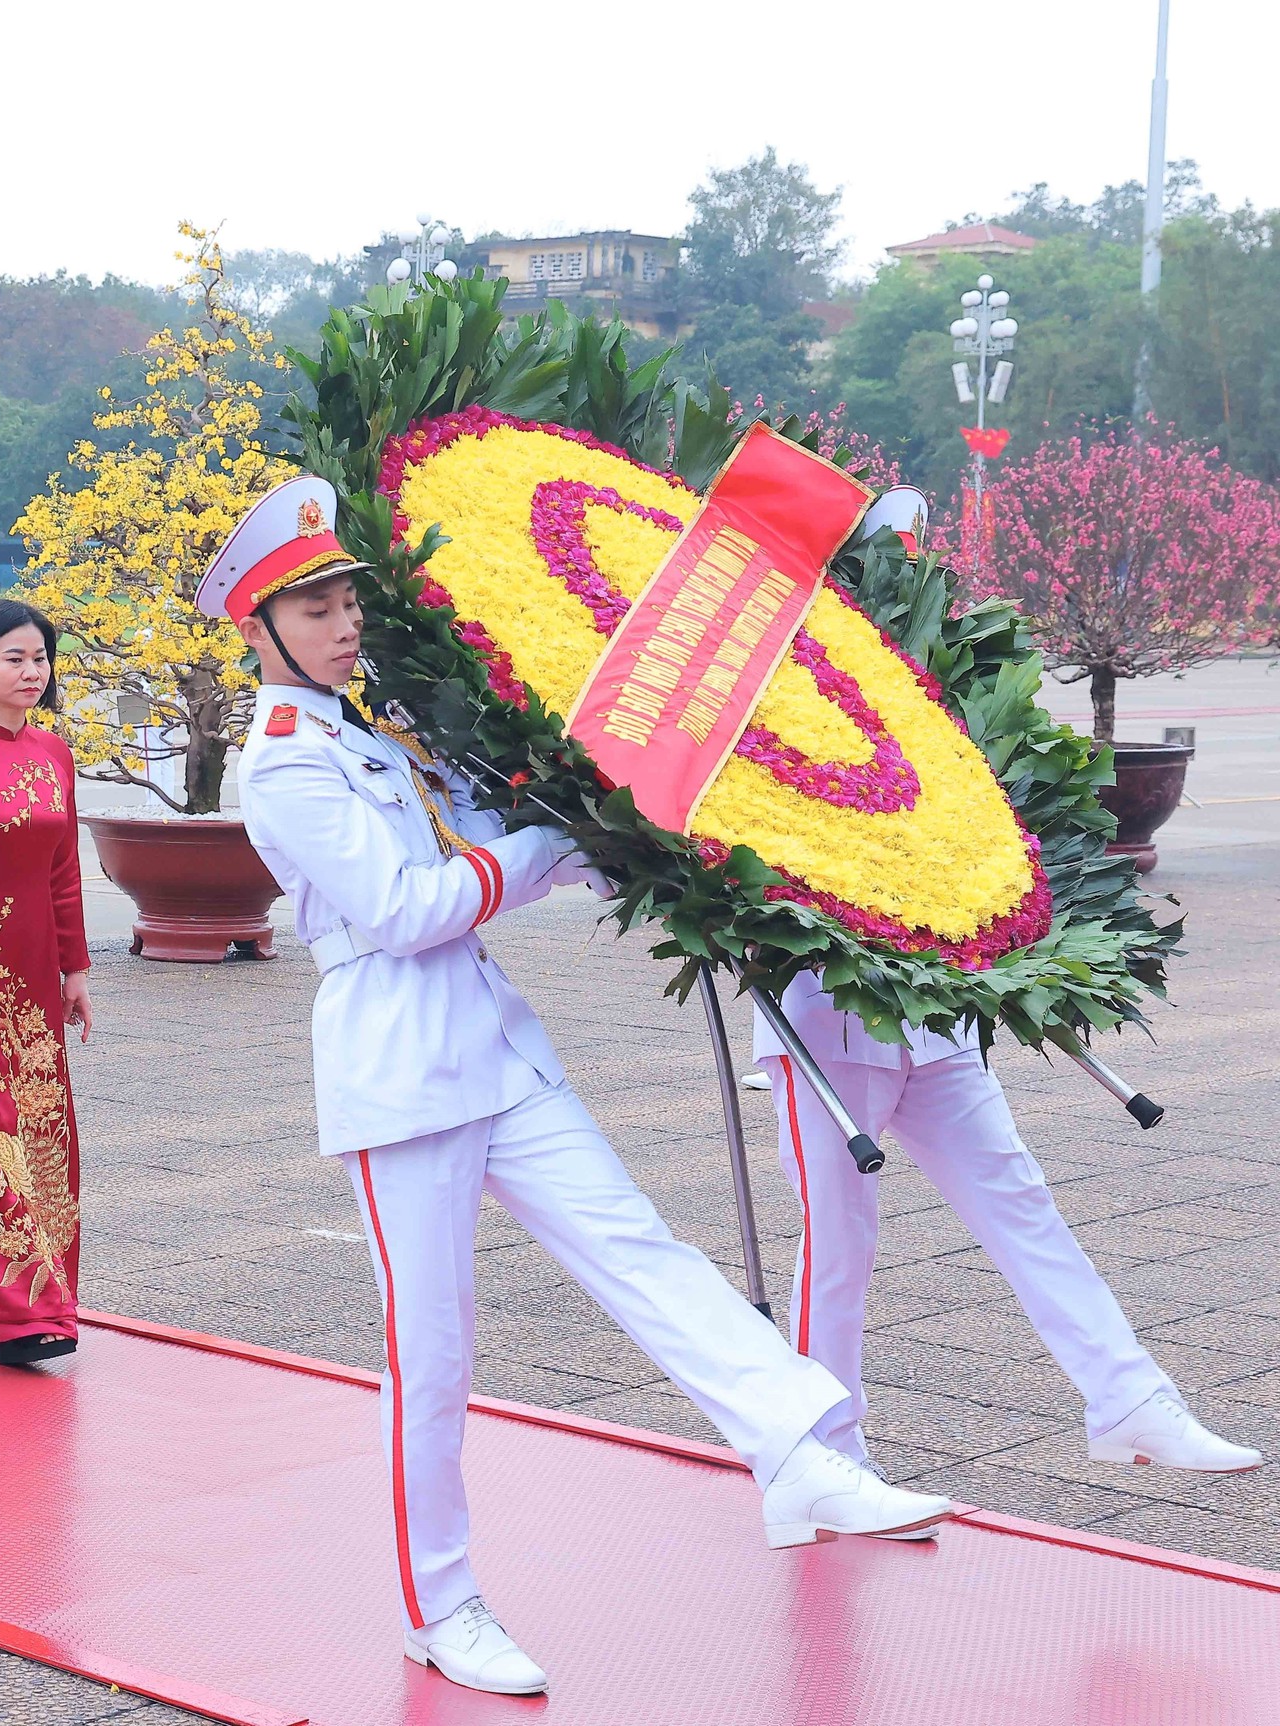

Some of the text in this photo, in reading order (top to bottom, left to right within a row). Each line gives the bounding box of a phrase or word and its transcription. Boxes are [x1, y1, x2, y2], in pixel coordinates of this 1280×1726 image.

[678, 566, 726, 604] HỒ
[692, 554, 736, 593] CHÍ
[671, 587, 724, 625] TỊCH
[652, 606, 707, 647] CHỦ
[644, 635, 693, 667] ƠN
[630, 651, 682, 695] NHỚ
[612, 682, 668, 720] ĐỜI
[597, 709, 656, 747] ĐỜI
[676, 699, 719, 746] THÀNH
